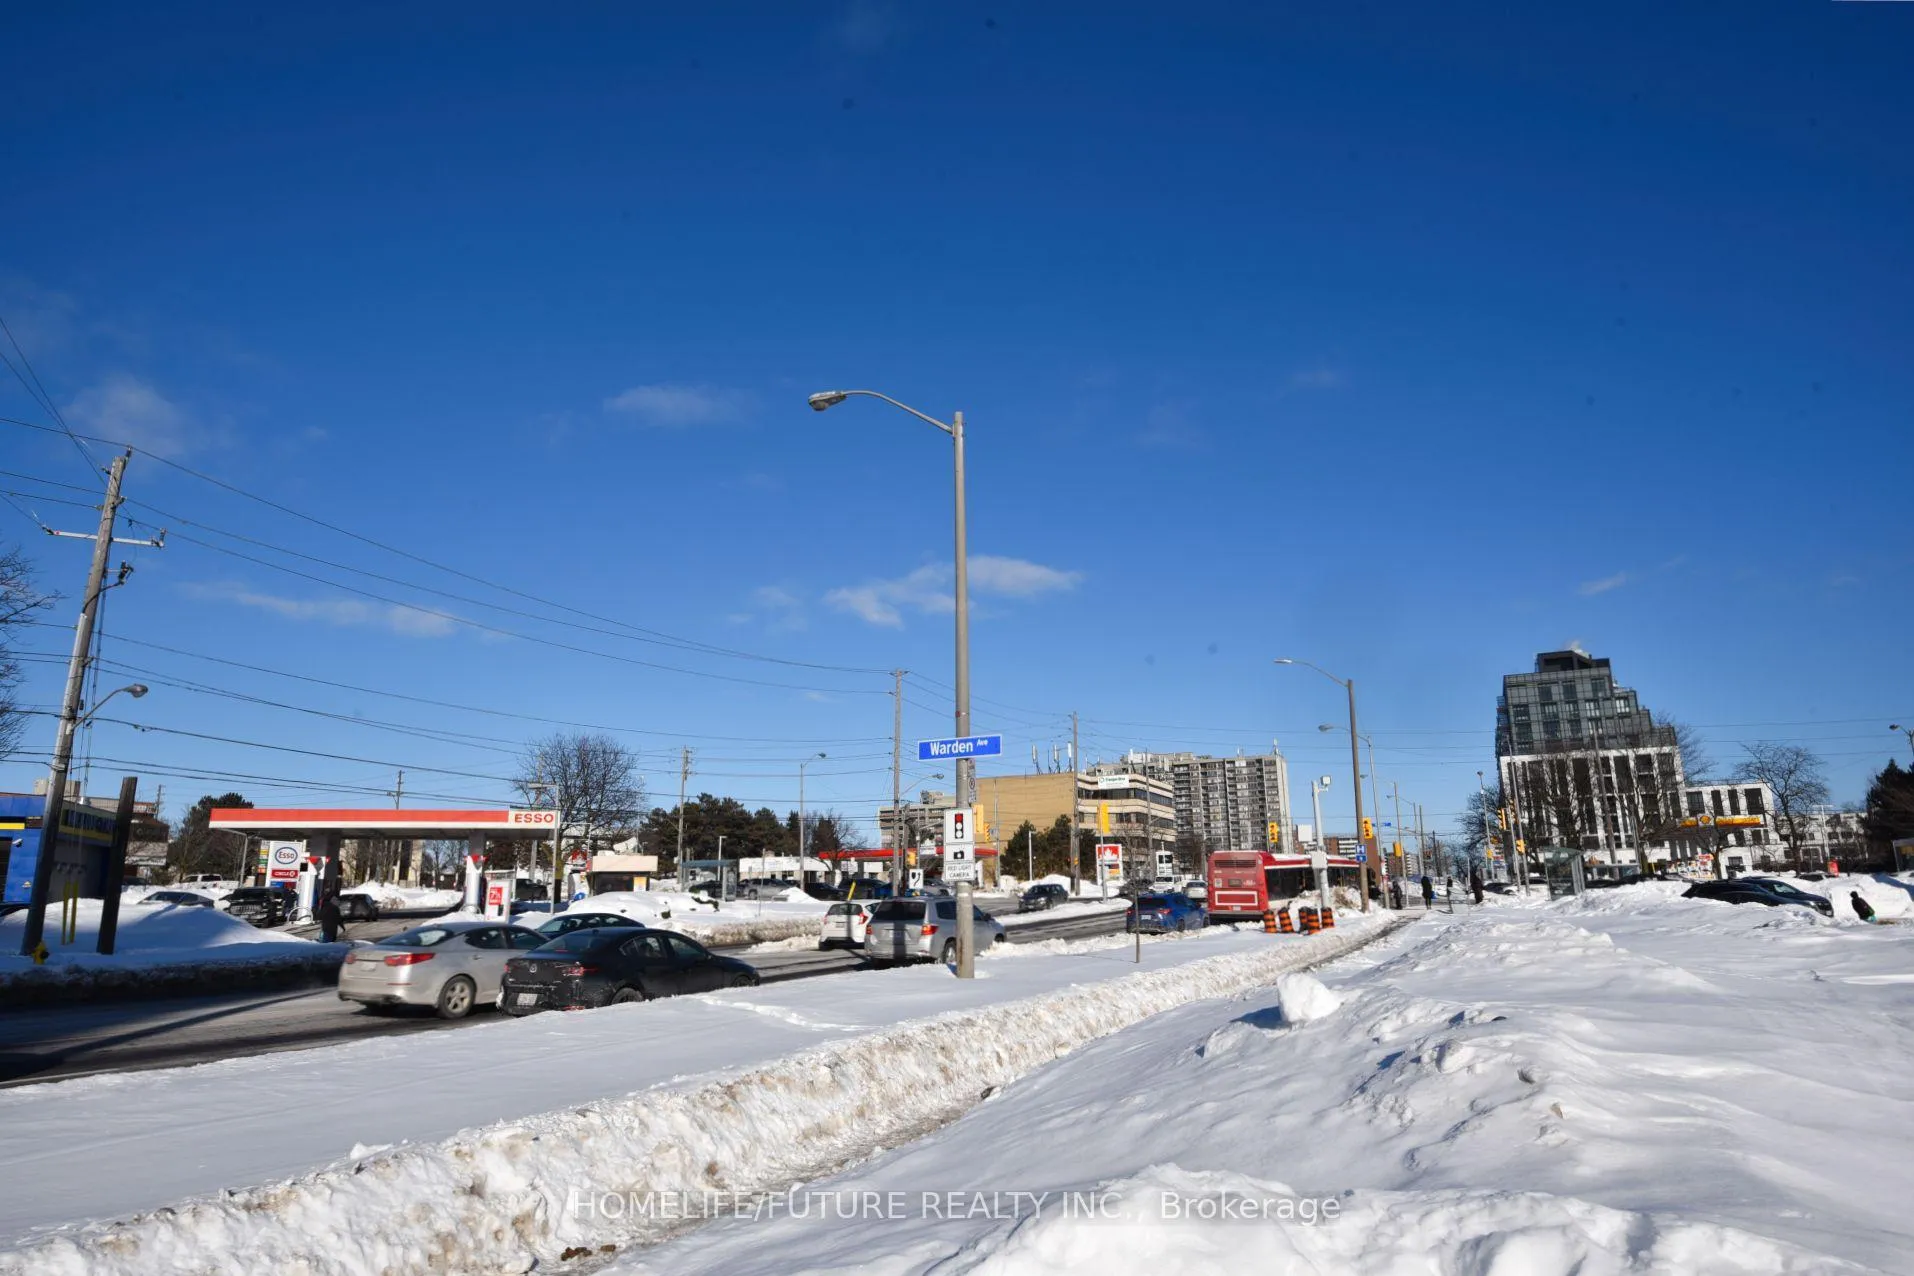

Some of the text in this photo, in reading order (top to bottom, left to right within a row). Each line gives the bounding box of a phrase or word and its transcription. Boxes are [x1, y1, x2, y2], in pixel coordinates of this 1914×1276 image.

[930, 738, 989, 756] Warden Ave
[514, 813, 554, 823] ESSO
[279, 851, 295, 859] Esso
